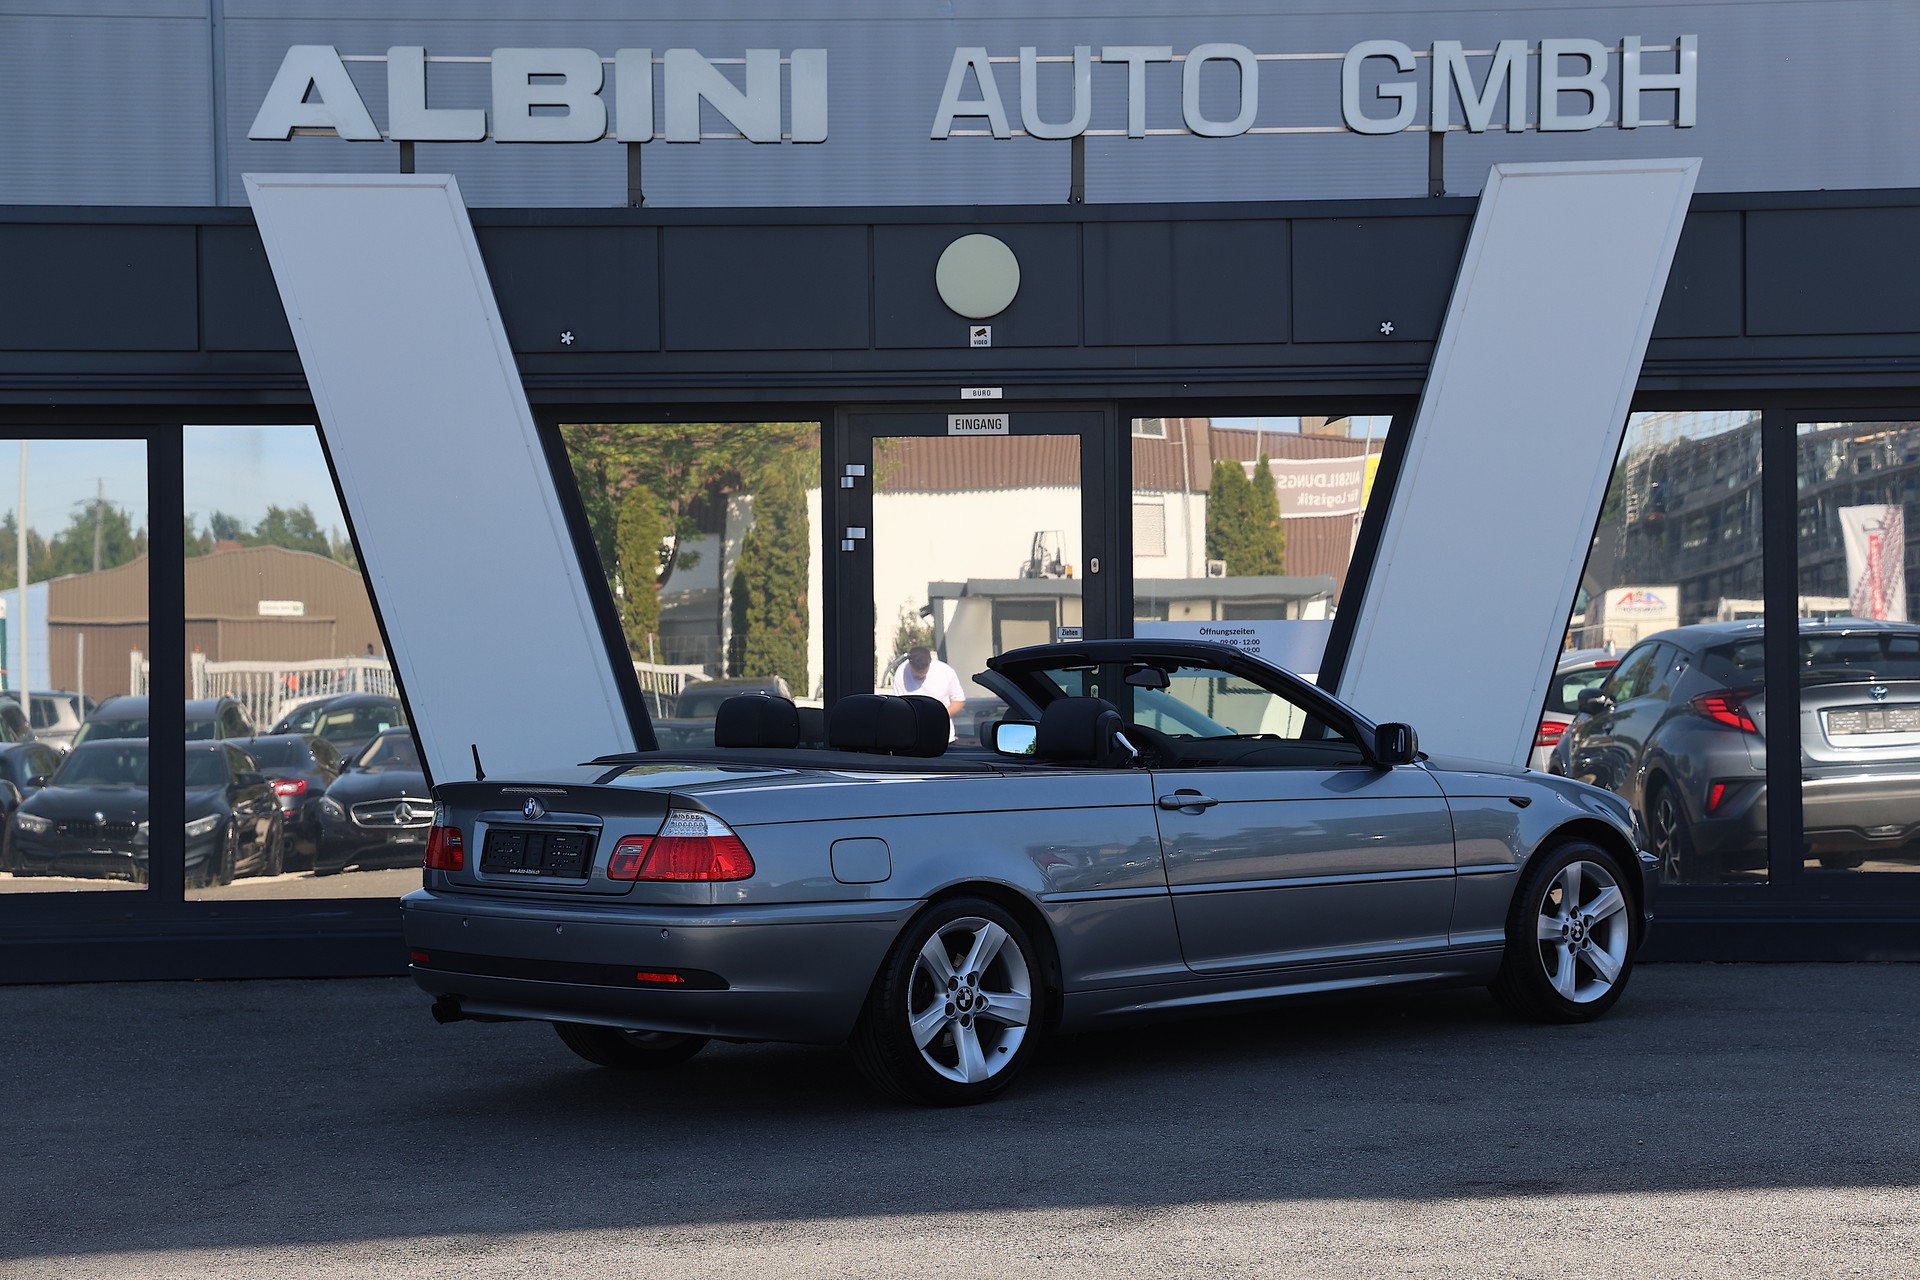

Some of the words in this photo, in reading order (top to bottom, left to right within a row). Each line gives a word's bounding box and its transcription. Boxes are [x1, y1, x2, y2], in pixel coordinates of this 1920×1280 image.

[247, 45, 828, 143] ALBINI
[930, 43, 1260, 140] AUTO
[1340, 33, 1700, 135] GMBH
[955, 418, 1002, 430] EINGANG
[1200, 626, 1255, 636] Öffnungszeiten
